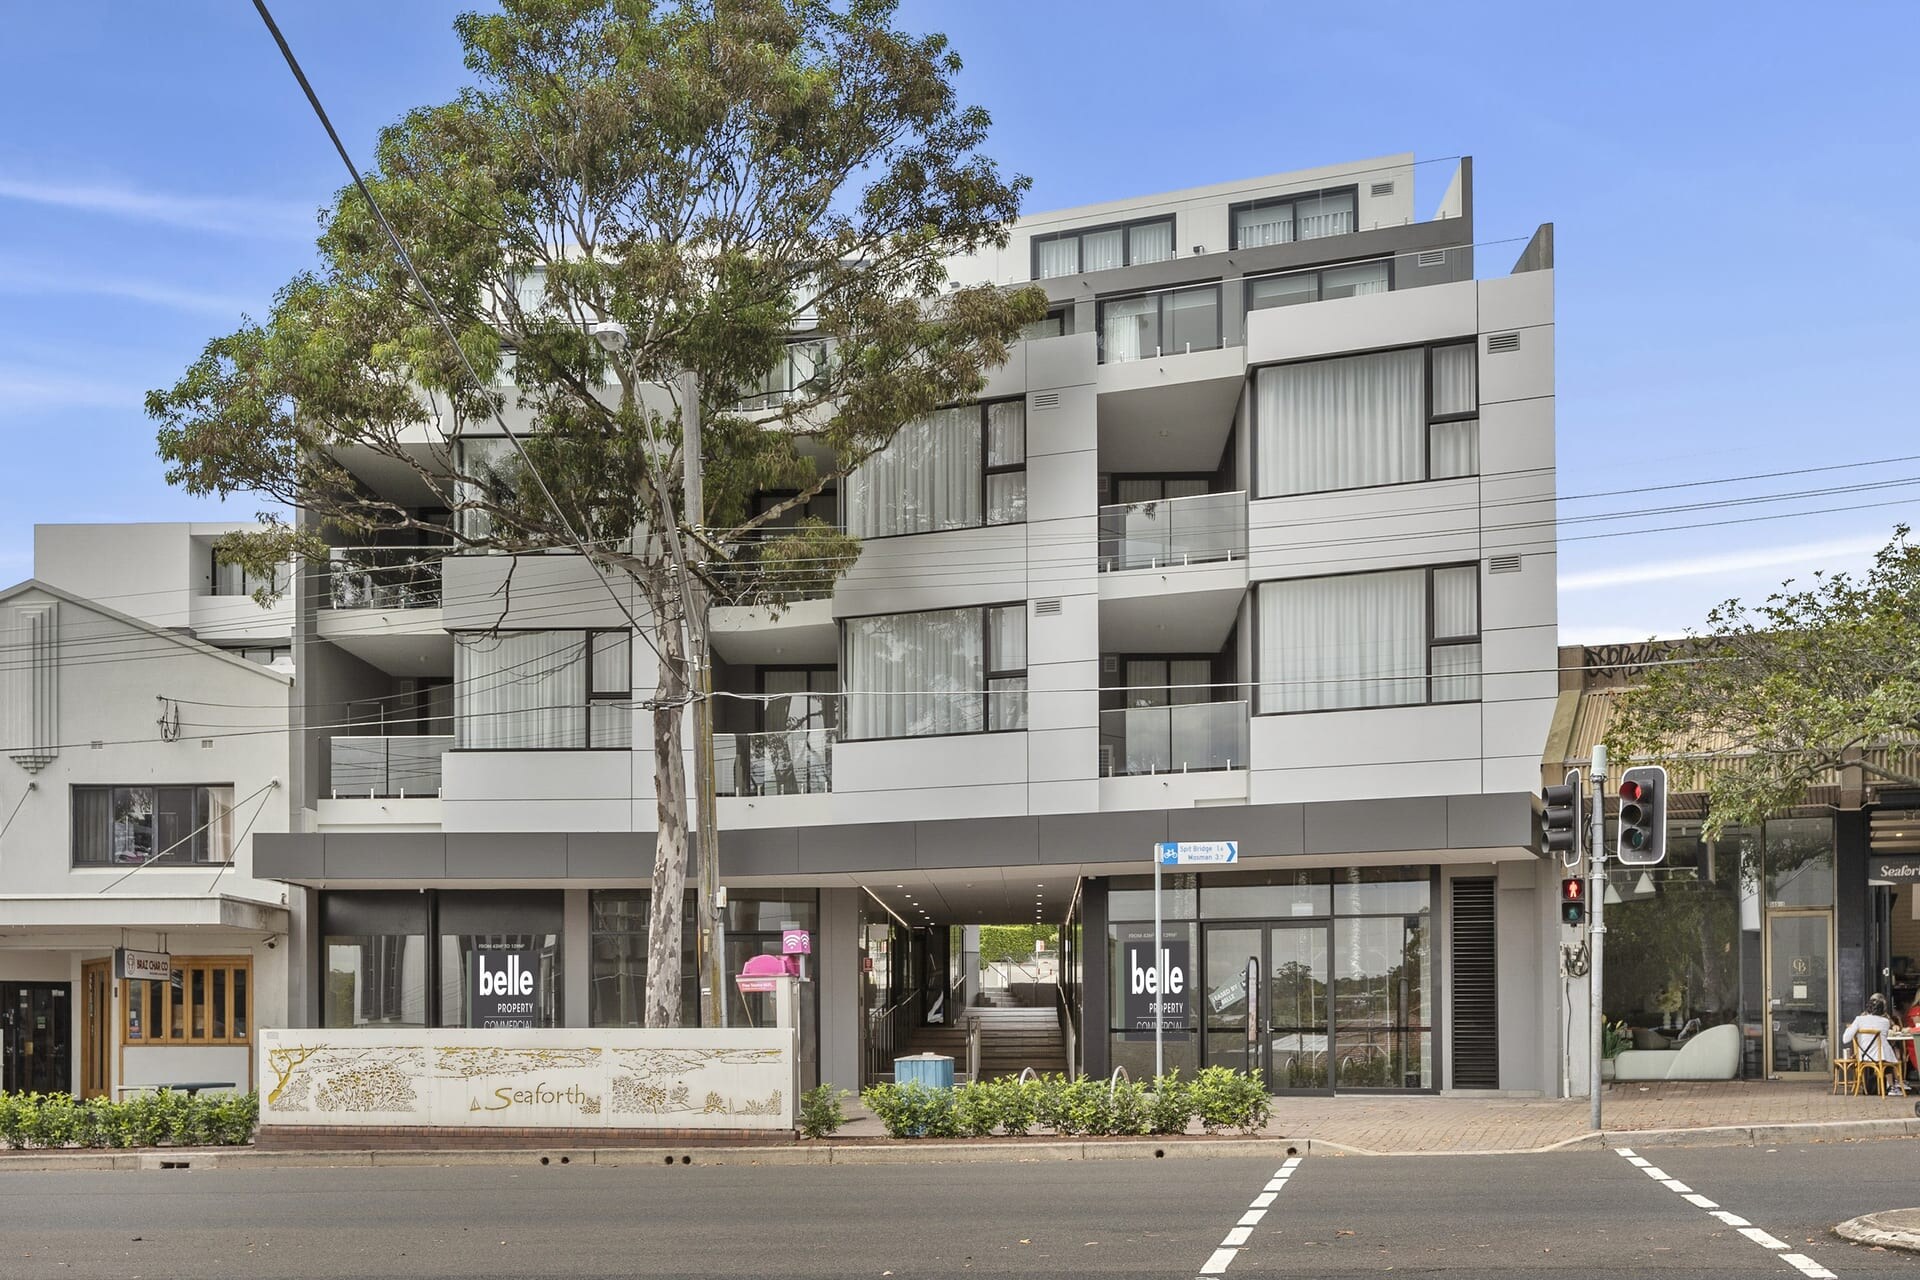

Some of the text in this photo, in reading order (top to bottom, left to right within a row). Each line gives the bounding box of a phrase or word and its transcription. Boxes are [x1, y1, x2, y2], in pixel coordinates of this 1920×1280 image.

[1180, 845, 1192, 853] Spit
[1193, 844, 1213, 853] Bridge
[480, 954, 534, 996] belle
[497, 1003, 533, 1013] PROPERTY
[484, 1082, 586, 1111] Seaforth
